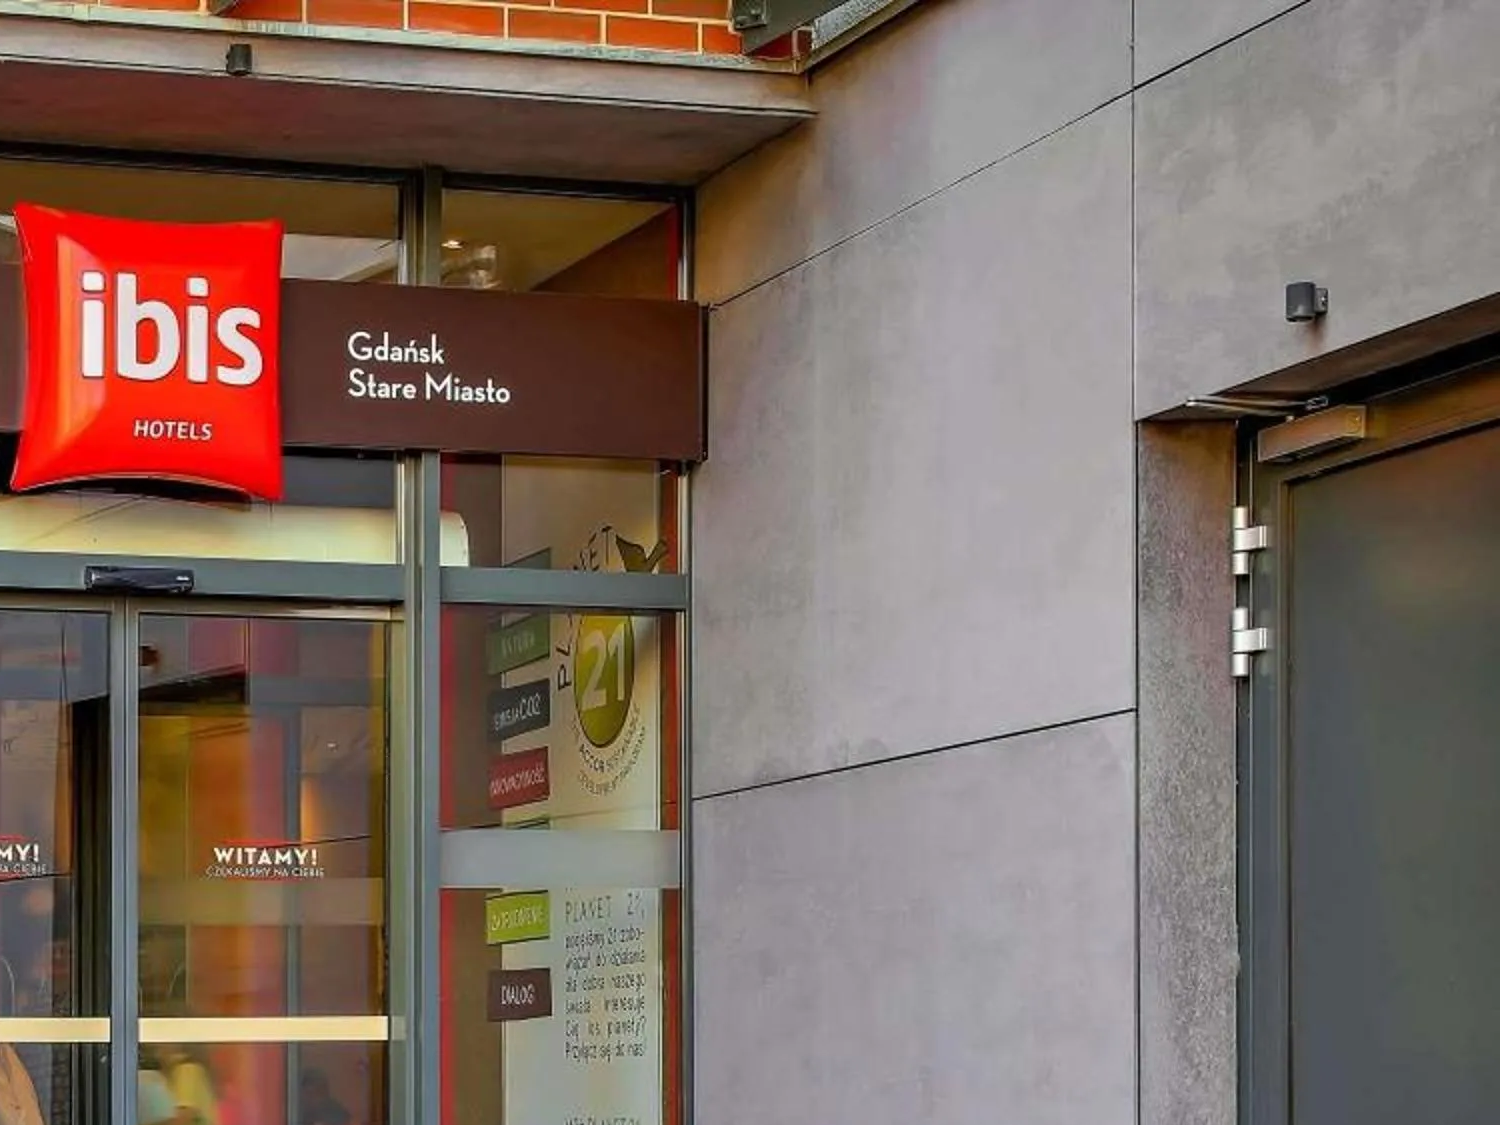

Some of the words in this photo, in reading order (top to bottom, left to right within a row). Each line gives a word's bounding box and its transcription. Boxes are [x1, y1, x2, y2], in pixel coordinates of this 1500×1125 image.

[80, 271, 264, 387] ibis
[347, 330, 445, 366] Gdańsk
[347, 368, 418, 401] Stare
[424, 372, 512, 405] Miasto
[132, 418, 213, 442] HOTELS
[580, 623, 627, 710] 21
[213, 847, 318, 866] WITAMY!
